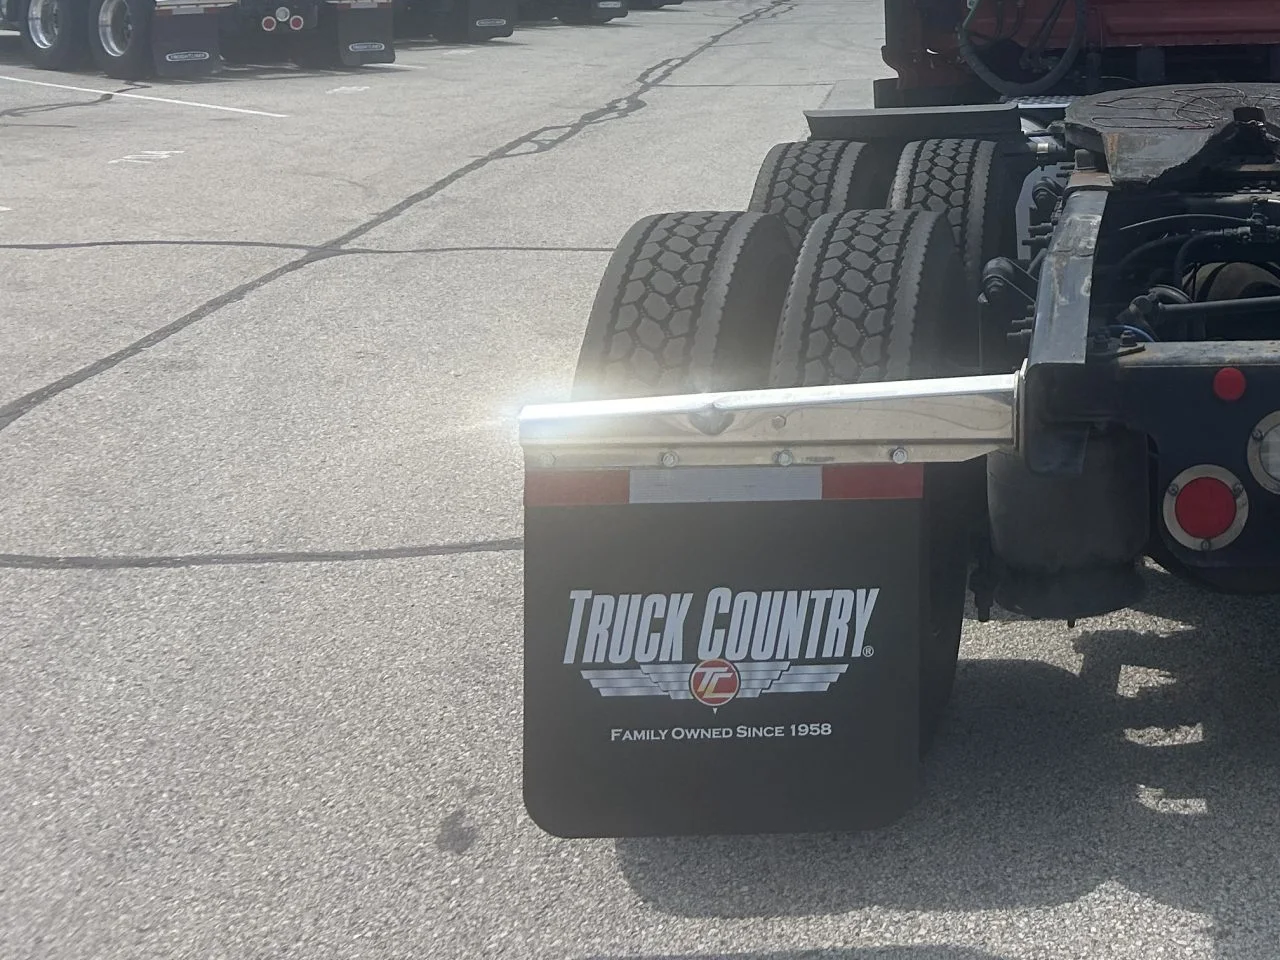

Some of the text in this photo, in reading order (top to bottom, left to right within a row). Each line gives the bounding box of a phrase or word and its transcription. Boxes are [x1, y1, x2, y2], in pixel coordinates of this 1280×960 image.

[563, 589, 693, 664] TRUCK
[610, 722, 832, 742] FAMILY OWNED SINCE 1958
